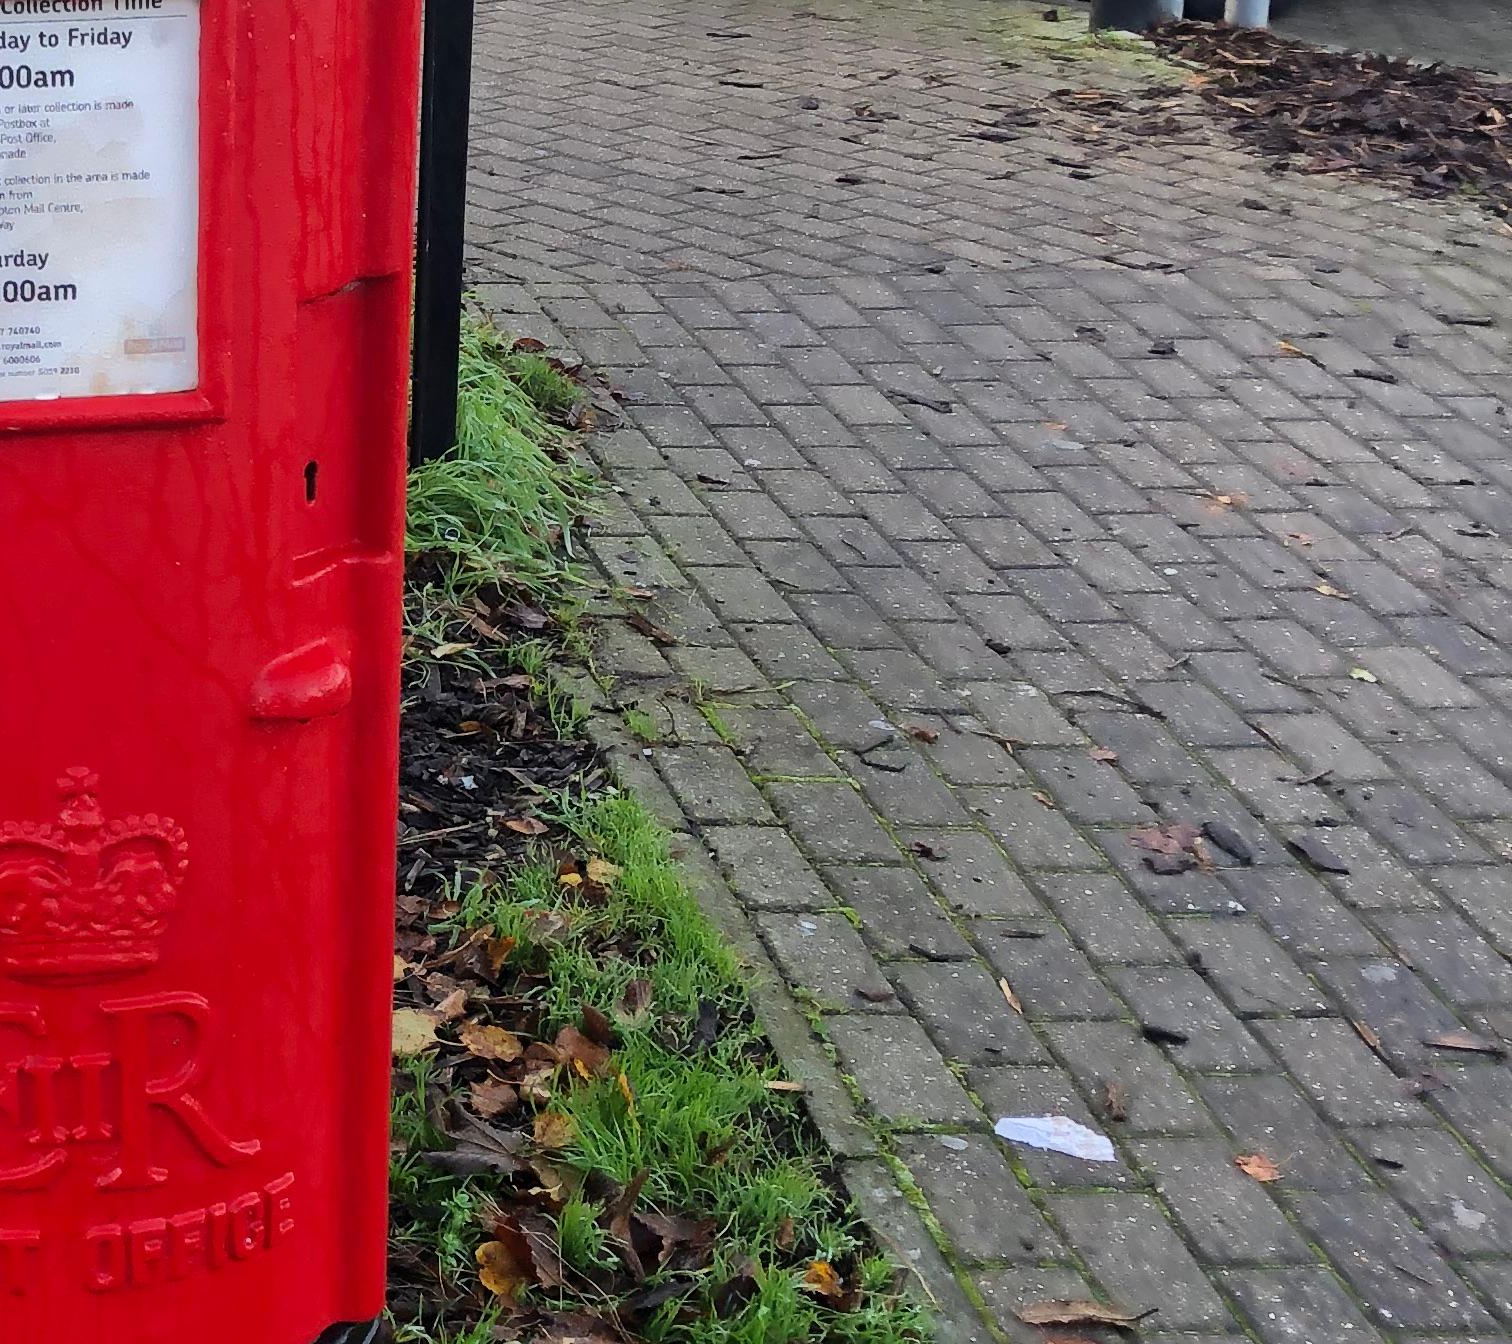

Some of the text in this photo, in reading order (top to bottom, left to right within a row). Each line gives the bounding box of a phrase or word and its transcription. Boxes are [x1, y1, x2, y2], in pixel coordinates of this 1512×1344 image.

[38, 30, 59, 48] to
[68, 26, 133, 49] Friday
[44, 100, 92, 113] collection
[94, 100, 102, 110] is
[105, 99, 134, 111] made
[0, 133, 23, 145] Post
[54, 173, 64, 184] in
[66, 172, 83, 183] the
[121, 169, 151, 181] made
[83, 1171, 295, 1294] OFFICE
